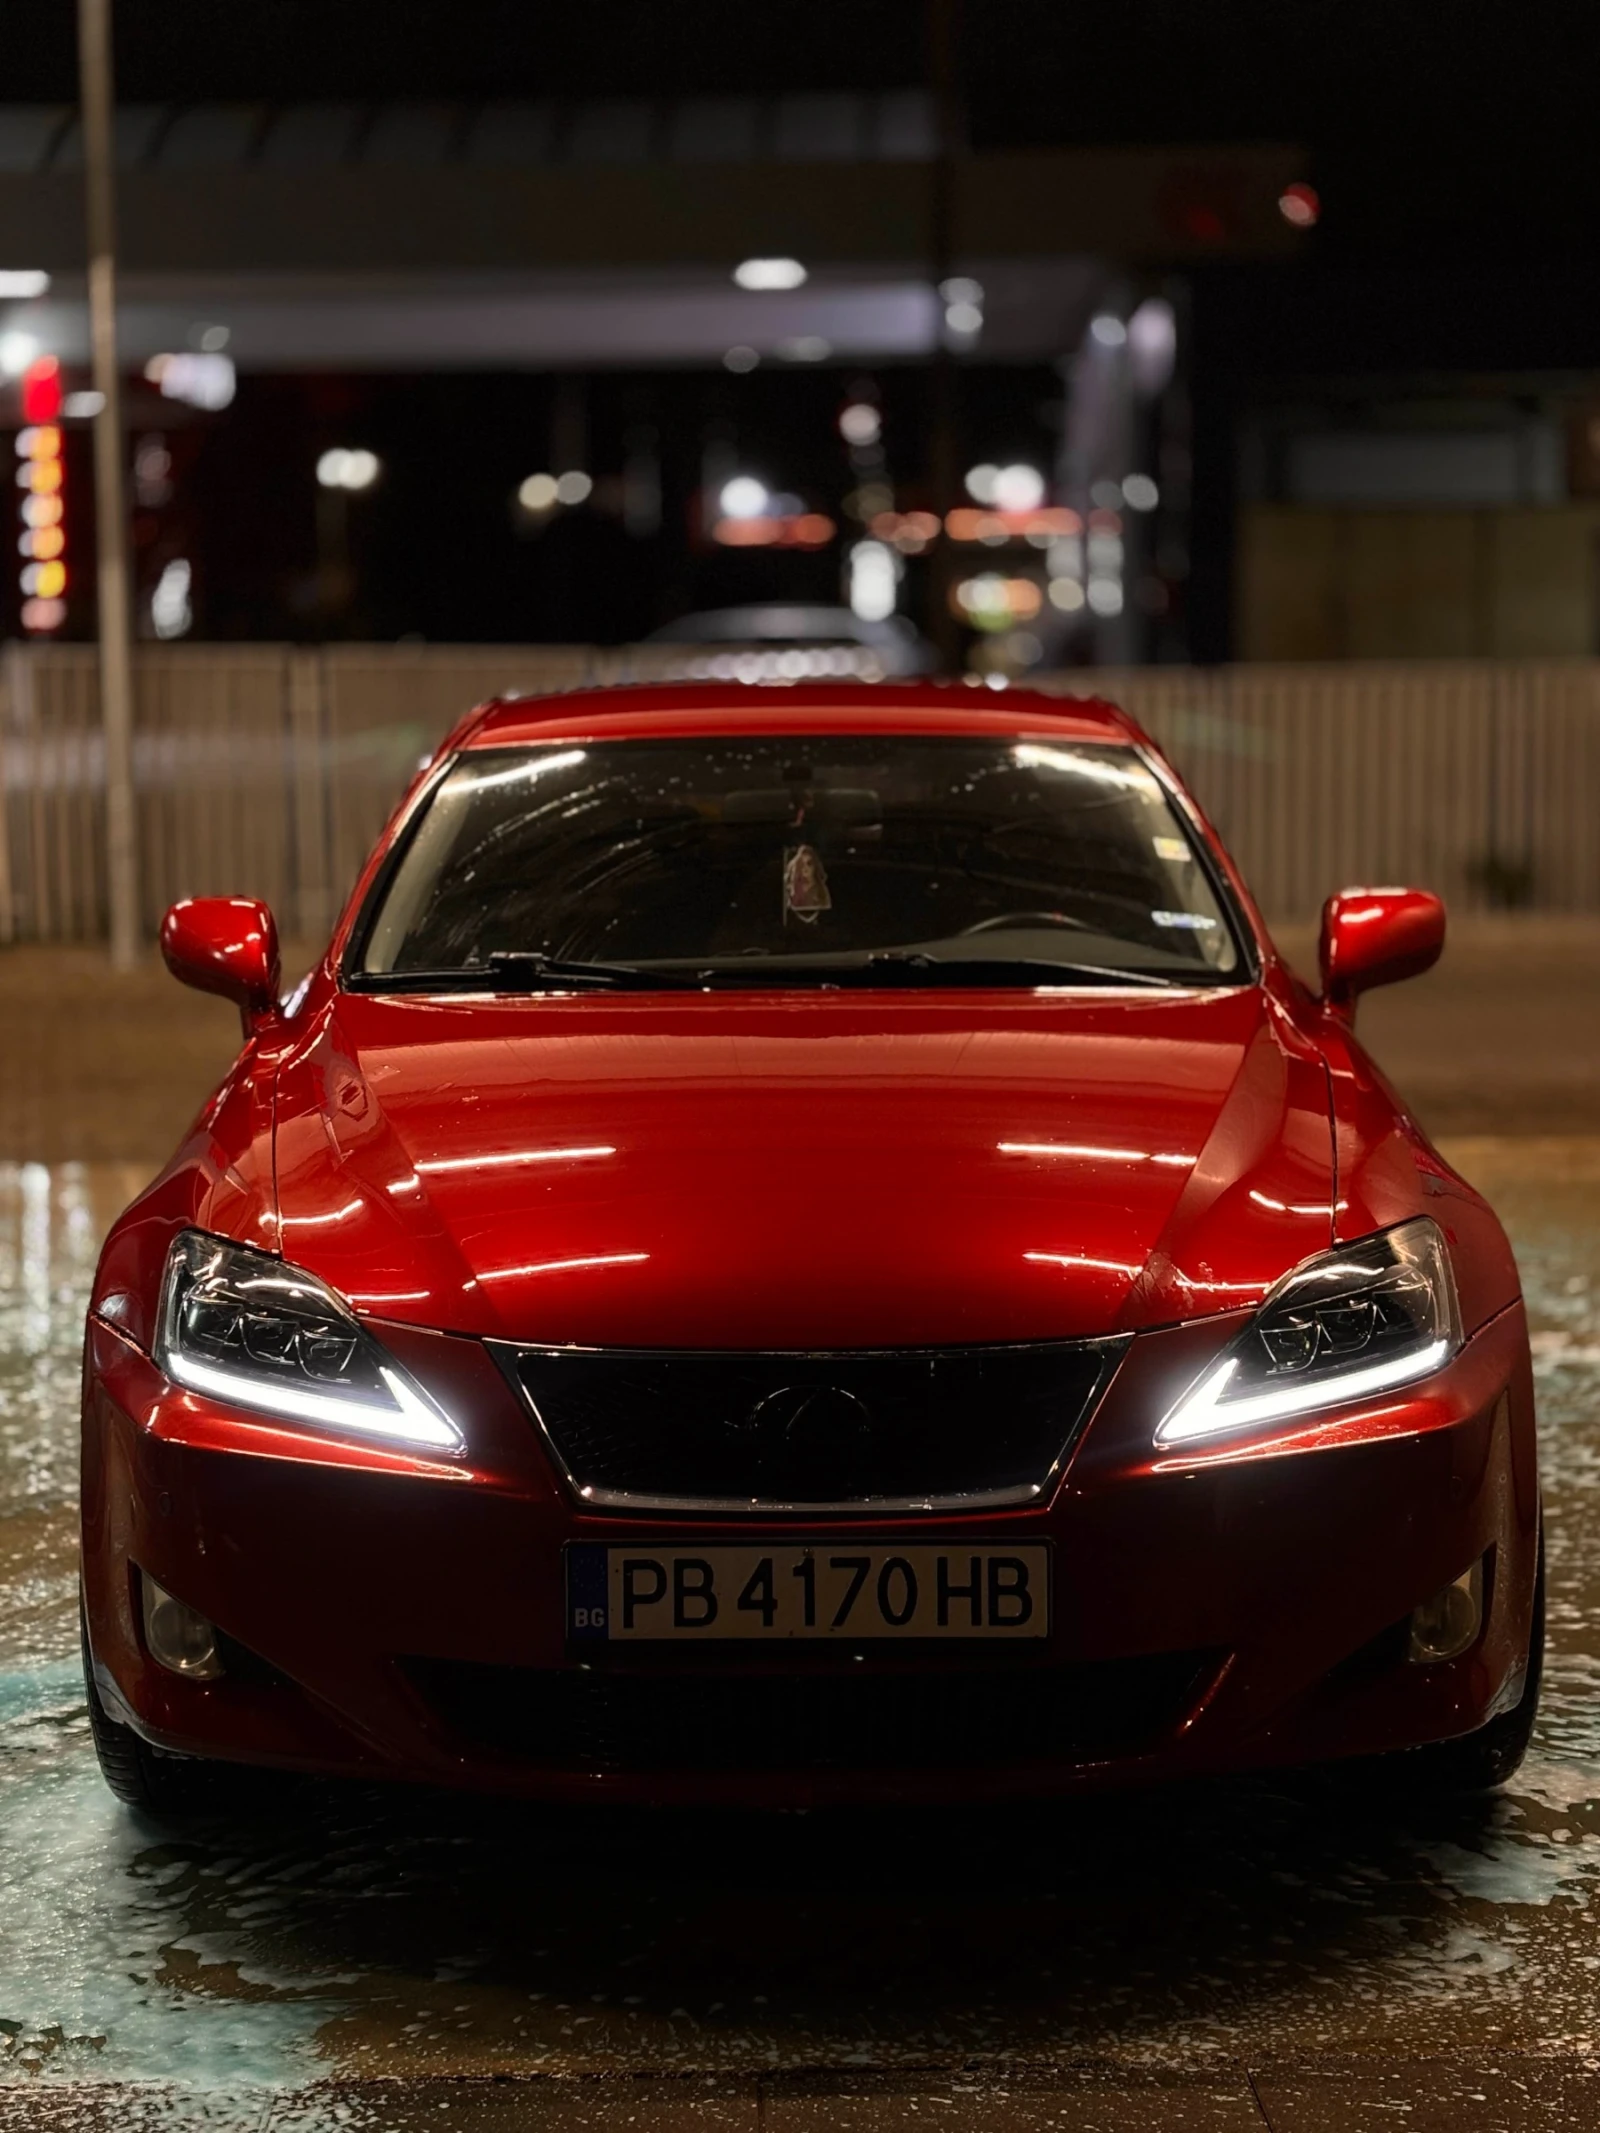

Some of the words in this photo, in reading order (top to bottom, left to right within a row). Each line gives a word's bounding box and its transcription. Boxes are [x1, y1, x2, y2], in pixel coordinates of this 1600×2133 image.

[622, 1558, 718, 1629] PB
[737, 1557, 918, 1627] 4170
[936, 1556, 1033, 1626] HB
[574, 1608, 605, 1627] BG
